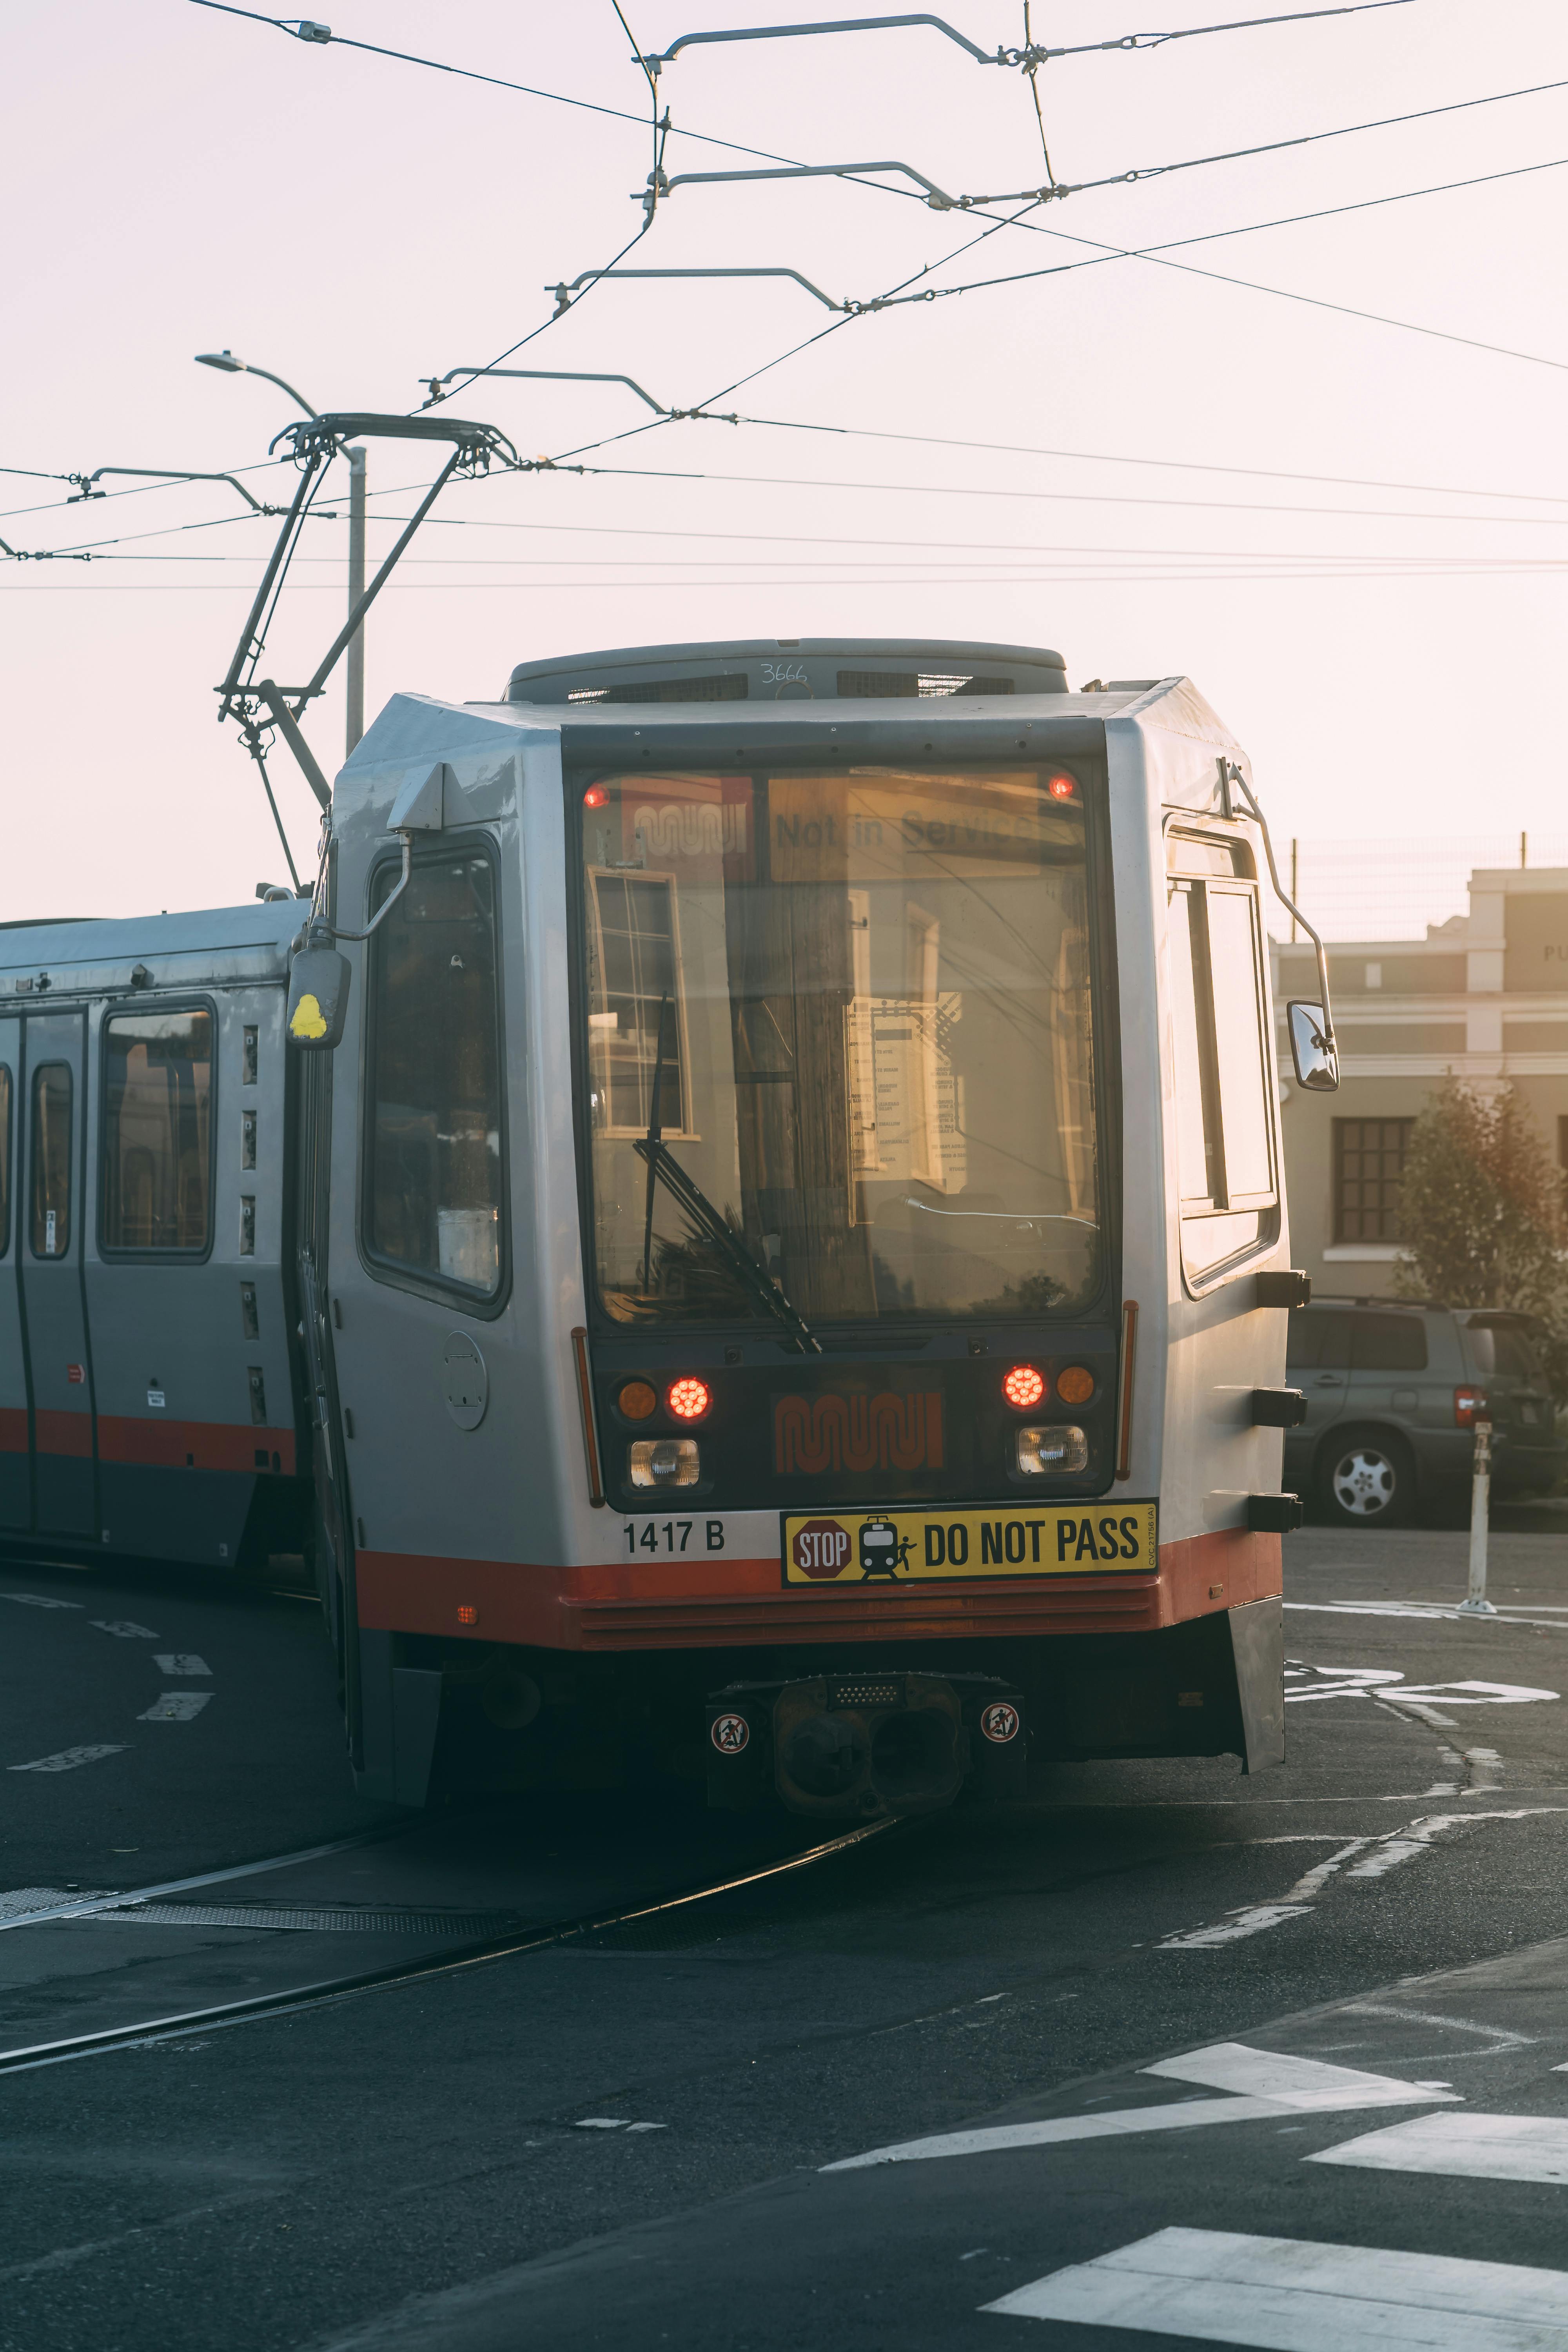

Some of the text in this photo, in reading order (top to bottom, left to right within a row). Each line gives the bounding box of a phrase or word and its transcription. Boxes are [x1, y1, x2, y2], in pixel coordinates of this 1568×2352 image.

[777, 810, 1033, 848] Not in Service
[623, 1520, 725, 1553] 1417 B
[800, 1532, 847, 1568] STOP
[924, 1517, 1139, 1567] DO NOT PASS
